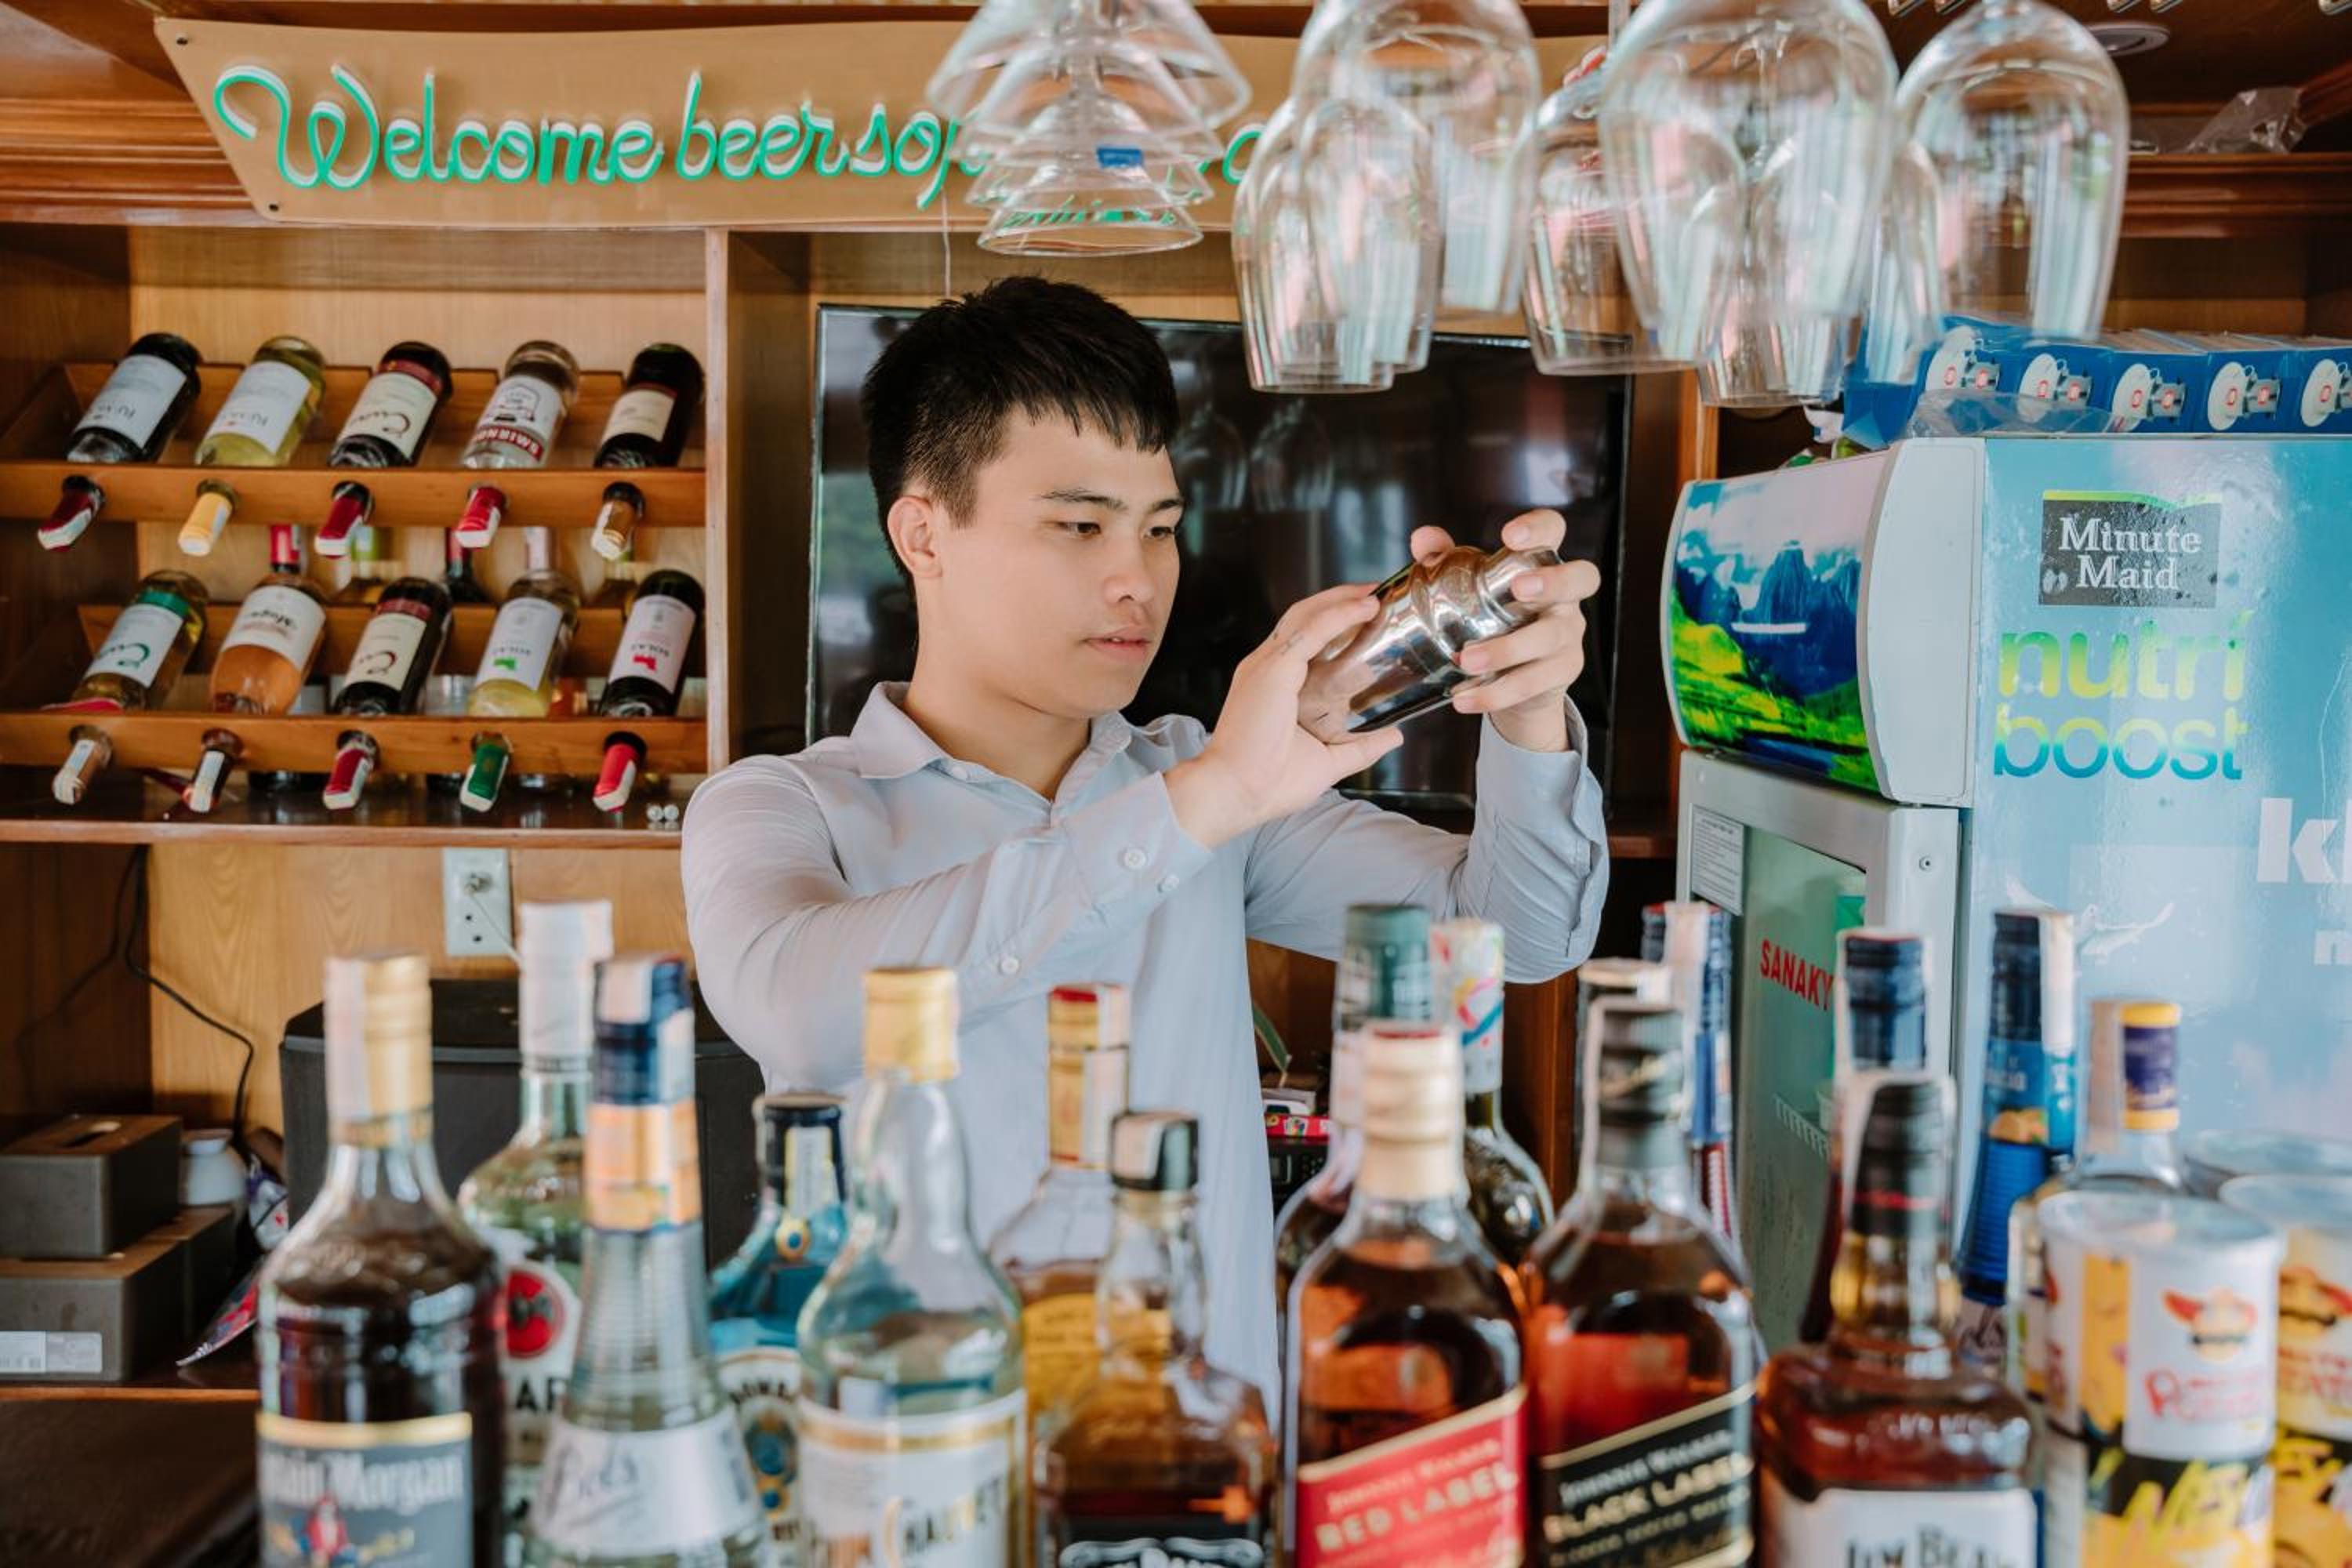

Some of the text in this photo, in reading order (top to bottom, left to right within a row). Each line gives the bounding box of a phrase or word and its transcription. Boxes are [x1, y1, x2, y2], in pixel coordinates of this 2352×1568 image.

[214, 64, 665, 190] Welcome
[2059, 516, 2204, 554] Minute
[2075, 554, 2180, 590] Maid
[1998, 609, 2254, 701] nutri
[1994, 702, 2249, 779] boost
[1761, 939, 1835, 1012] SANAKY
[1316, 1505, 1394, 1553] RED
[1399, 1459, 1519, 1525] LABEL
[1543, 1454, 1755, 1544] BLACK LABEL
